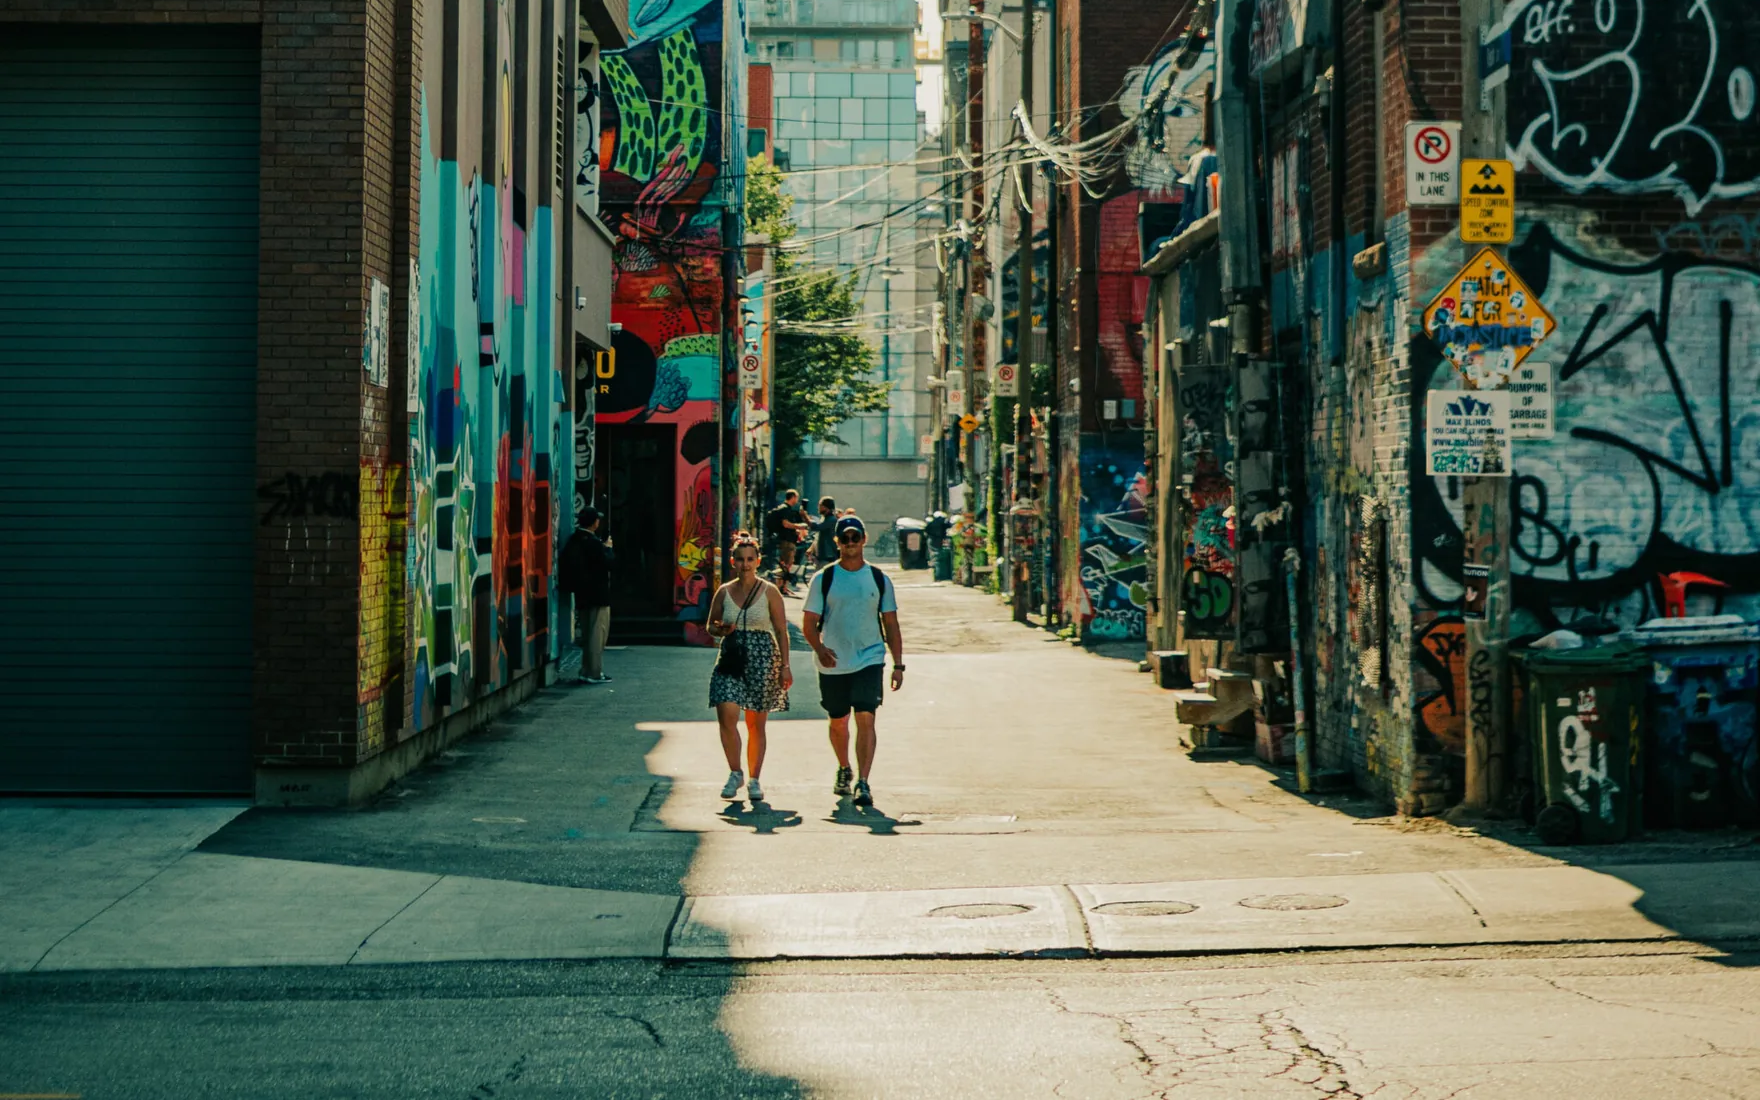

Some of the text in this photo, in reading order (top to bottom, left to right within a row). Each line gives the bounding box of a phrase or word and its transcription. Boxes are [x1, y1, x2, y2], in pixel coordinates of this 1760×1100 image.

[1415, 172, 1450, 182] IN THIS
[1420, 186, 1445, 196] LANE
[1462, 198, 1510, 208] SPEED CONTROL
[1479, 209, 1494, 218] ZONE
[1465, 276, 1511, 296] ATCH
[1521, 369, 1533, 379] NO
[1508, 383, 1547, 393] DUMPING
[1522, 396, 1533, 406] OF
